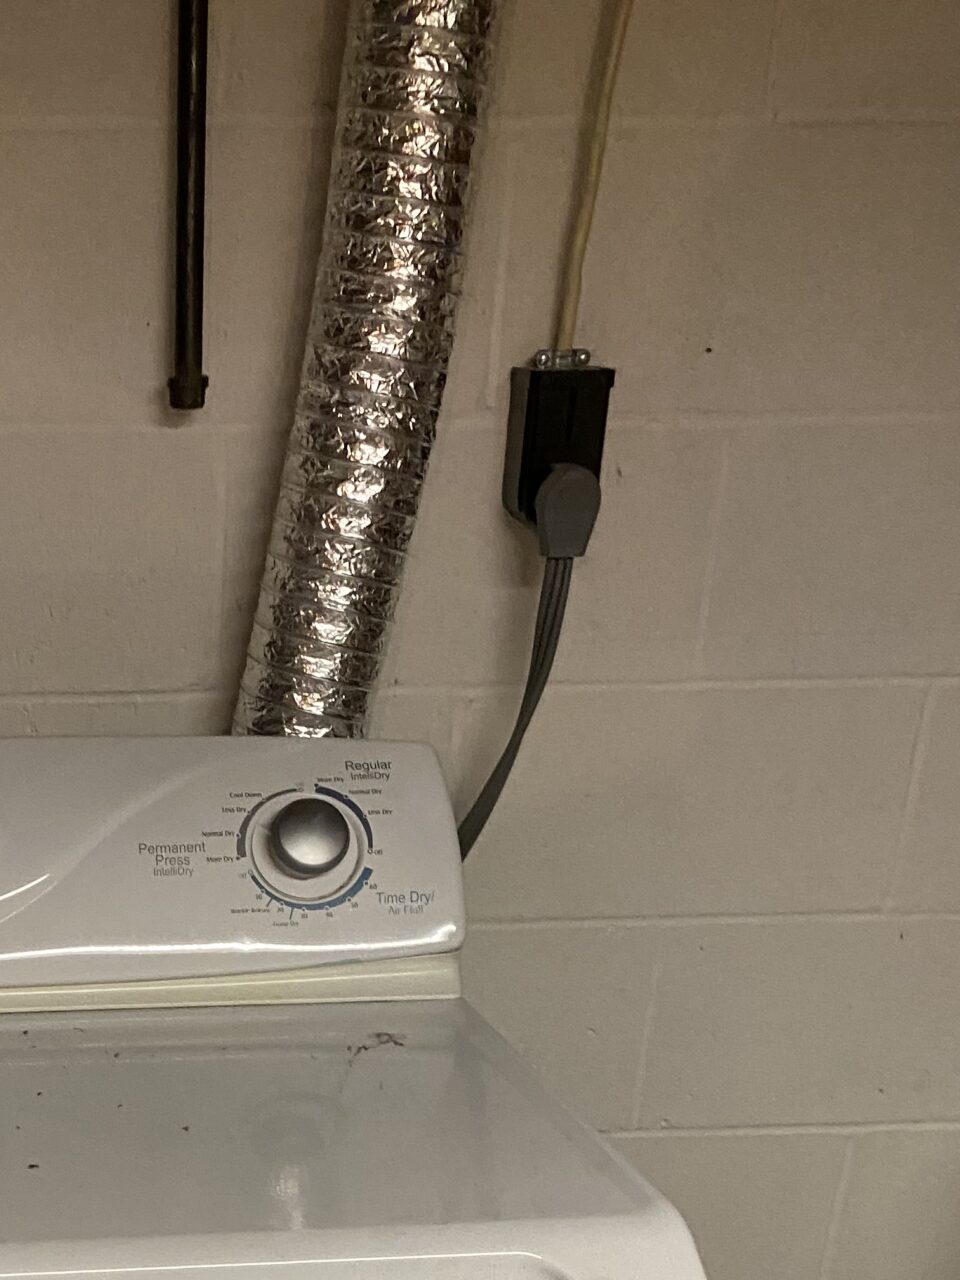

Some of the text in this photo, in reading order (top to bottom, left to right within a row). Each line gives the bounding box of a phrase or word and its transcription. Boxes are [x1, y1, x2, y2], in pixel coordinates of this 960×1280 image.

[344, 760, 392, 771] Regular
[138, 842, 206, 855] Permanent
[155, 855, 190, 866] Press
[153, 867, 194, 877] IntelliDry
[376, 890, 435, 907] Time Dry/
